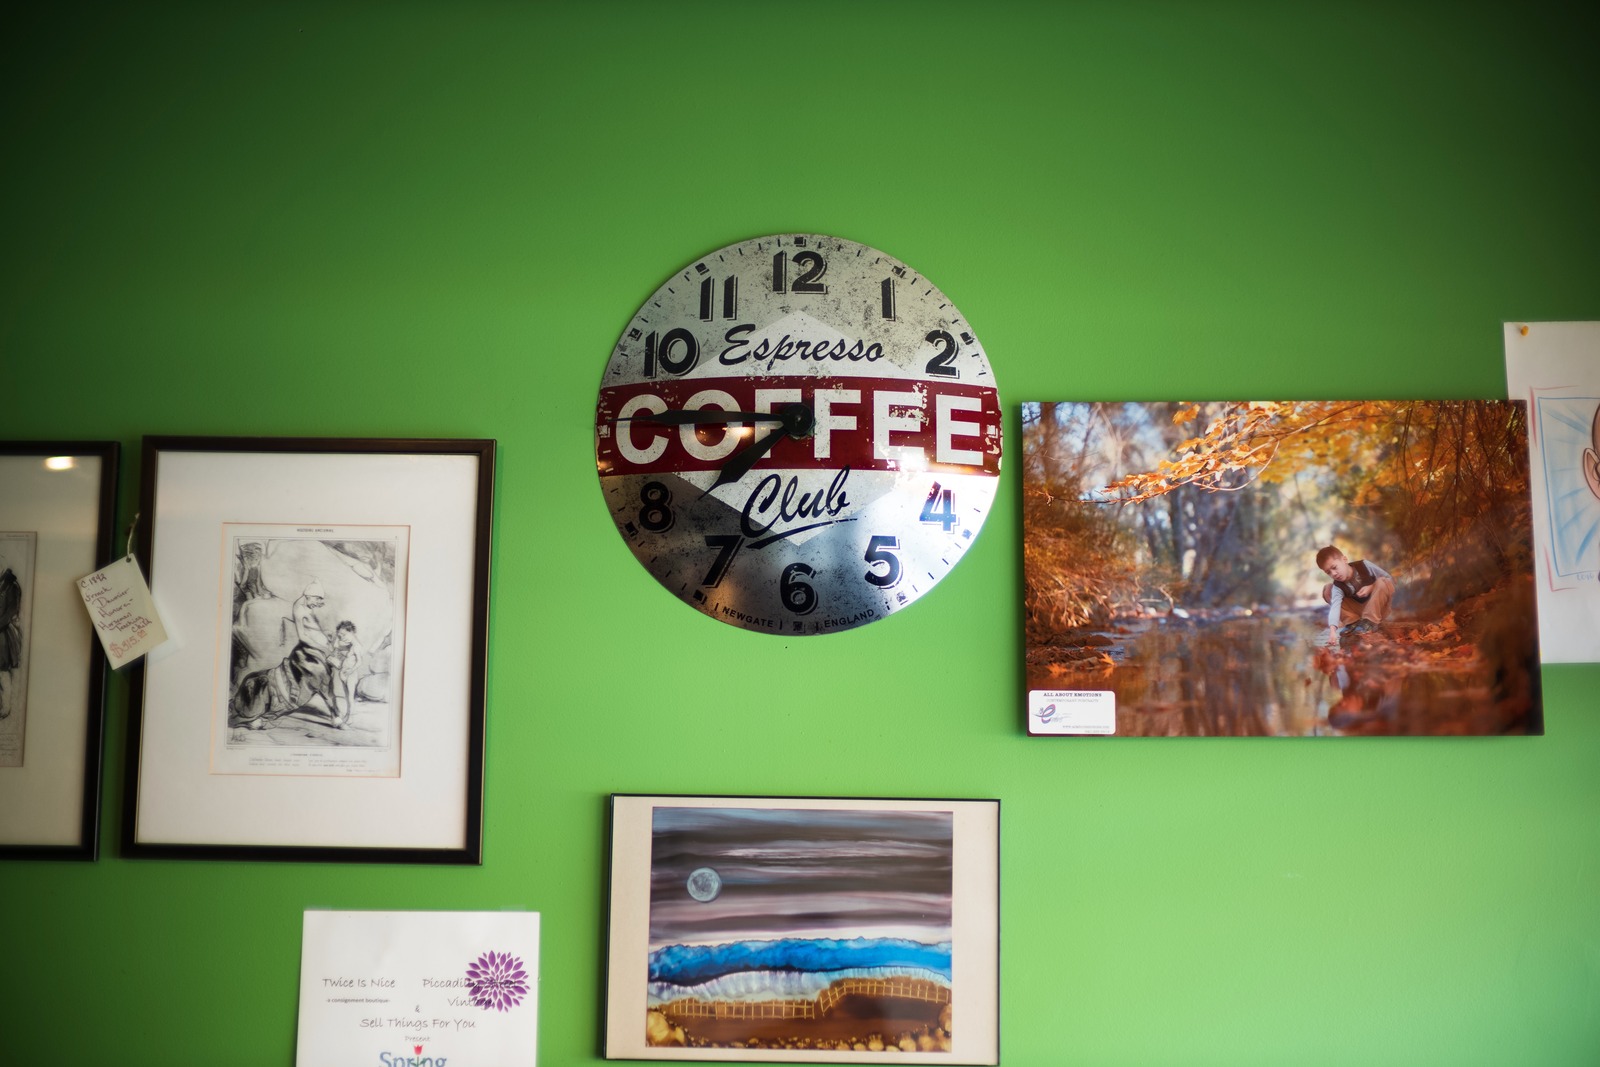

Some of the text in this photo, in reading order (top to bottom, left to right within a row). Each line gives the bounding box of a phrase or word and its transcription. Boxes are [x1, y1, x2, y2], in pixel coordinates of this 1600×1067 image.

[772, 250, 828, 295] 12
[700, 275, 738, 322] 11
[881, 277, 896, 321] 1
[643, 327, 701, 378] 10
[718, 323, 885, 371] Espresso
[925, 329, 960, 380] 2
[615, 388, 985, 466] COFFEE
[638, 481, 674, 534] 8
[740, 464, 852, 540] Club
[918, 481, 960, 534] 4
[703, 535, 746, 588] 7
[863, 535, 905, 588] 5
[780, 562, 819, 616] 6
[721, 605, 876, 629] NEWGATE ENGLAND
[322, 976, 396, 988] Twice Is Nice
[359, 1017, 477, 1032] Sell Things For You
